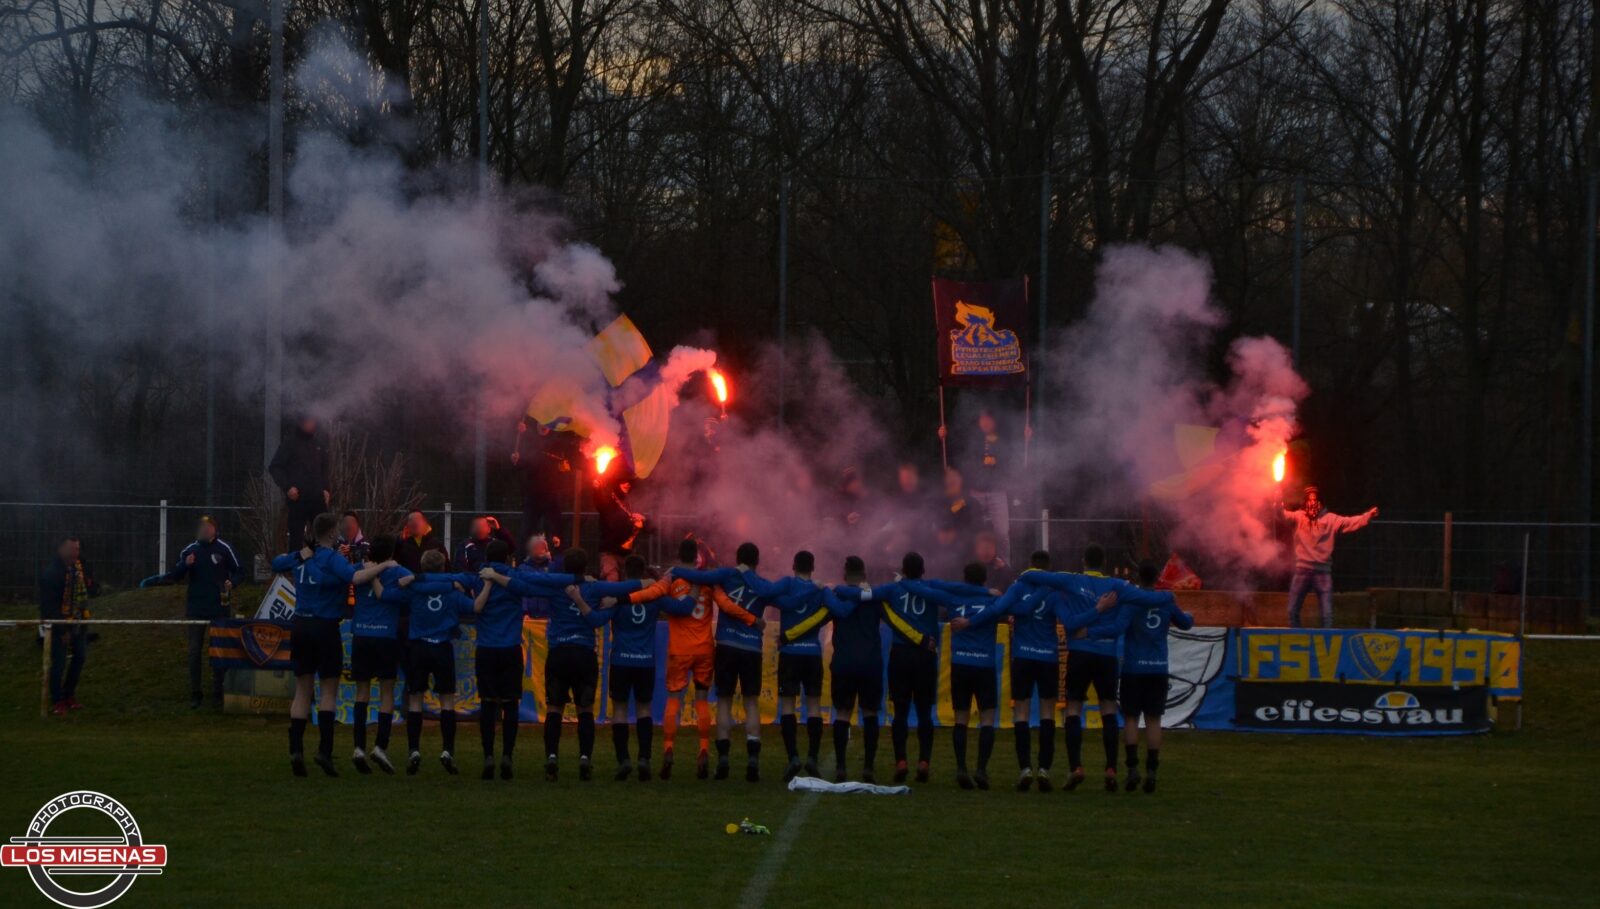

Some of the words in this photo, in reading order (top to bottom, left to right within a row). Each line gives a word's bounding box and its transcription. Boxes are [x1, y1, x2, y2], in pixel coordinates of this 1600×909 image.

[728, 585, 759, 610] 47
[899, 592, 926, 615] 10
[631, 603, 647, 624] 9
[1145, 608, 1162, 629] 5
[1249, 635, 1343, 681] FSV
[1405, 636, 1521, 688] 1990
[1255, 699, 1463, 724] effessvau
